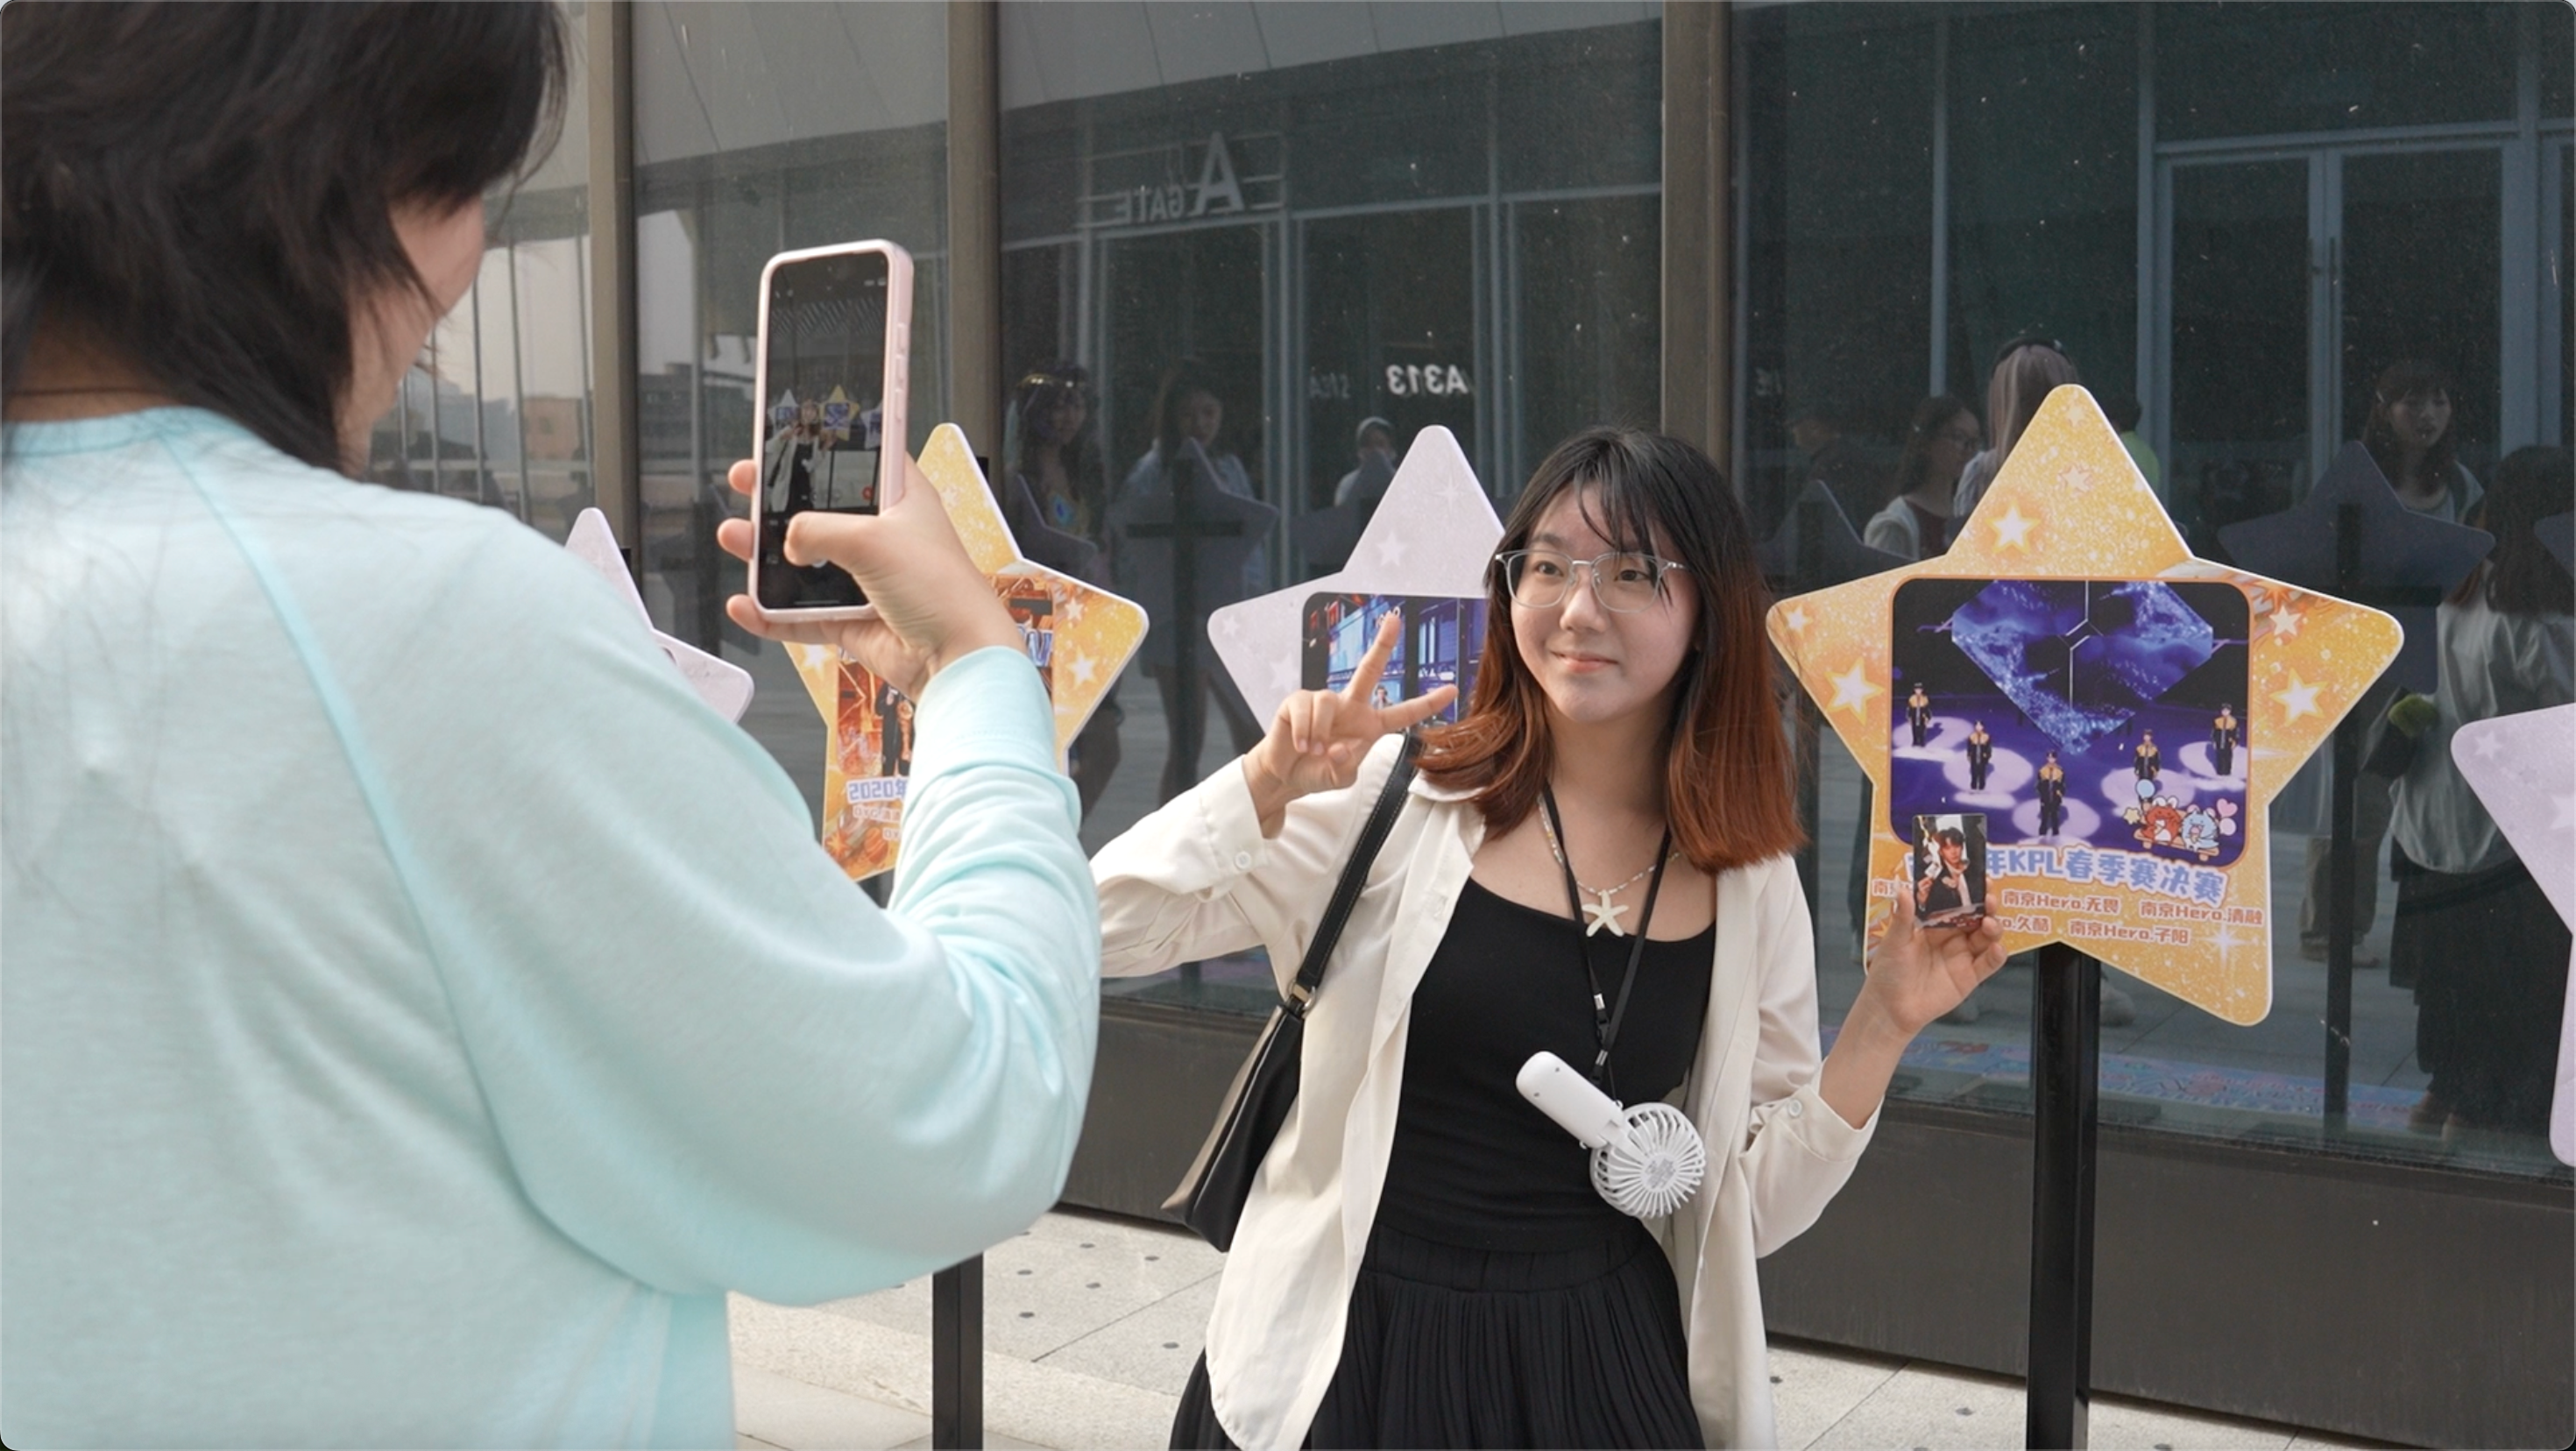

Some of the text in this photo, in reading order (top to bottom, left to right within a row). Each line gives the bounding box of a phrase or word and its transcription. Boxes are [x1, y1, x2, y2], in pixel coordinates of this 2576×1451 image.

[1907, 849, 2224, 903] 年KPL春季赛决赛
[2003, 891, 2262, 925] 南京Hero.无畏 南京Hero.清融
[2070, 921, 2189, 944] 南京Hero.子阳
